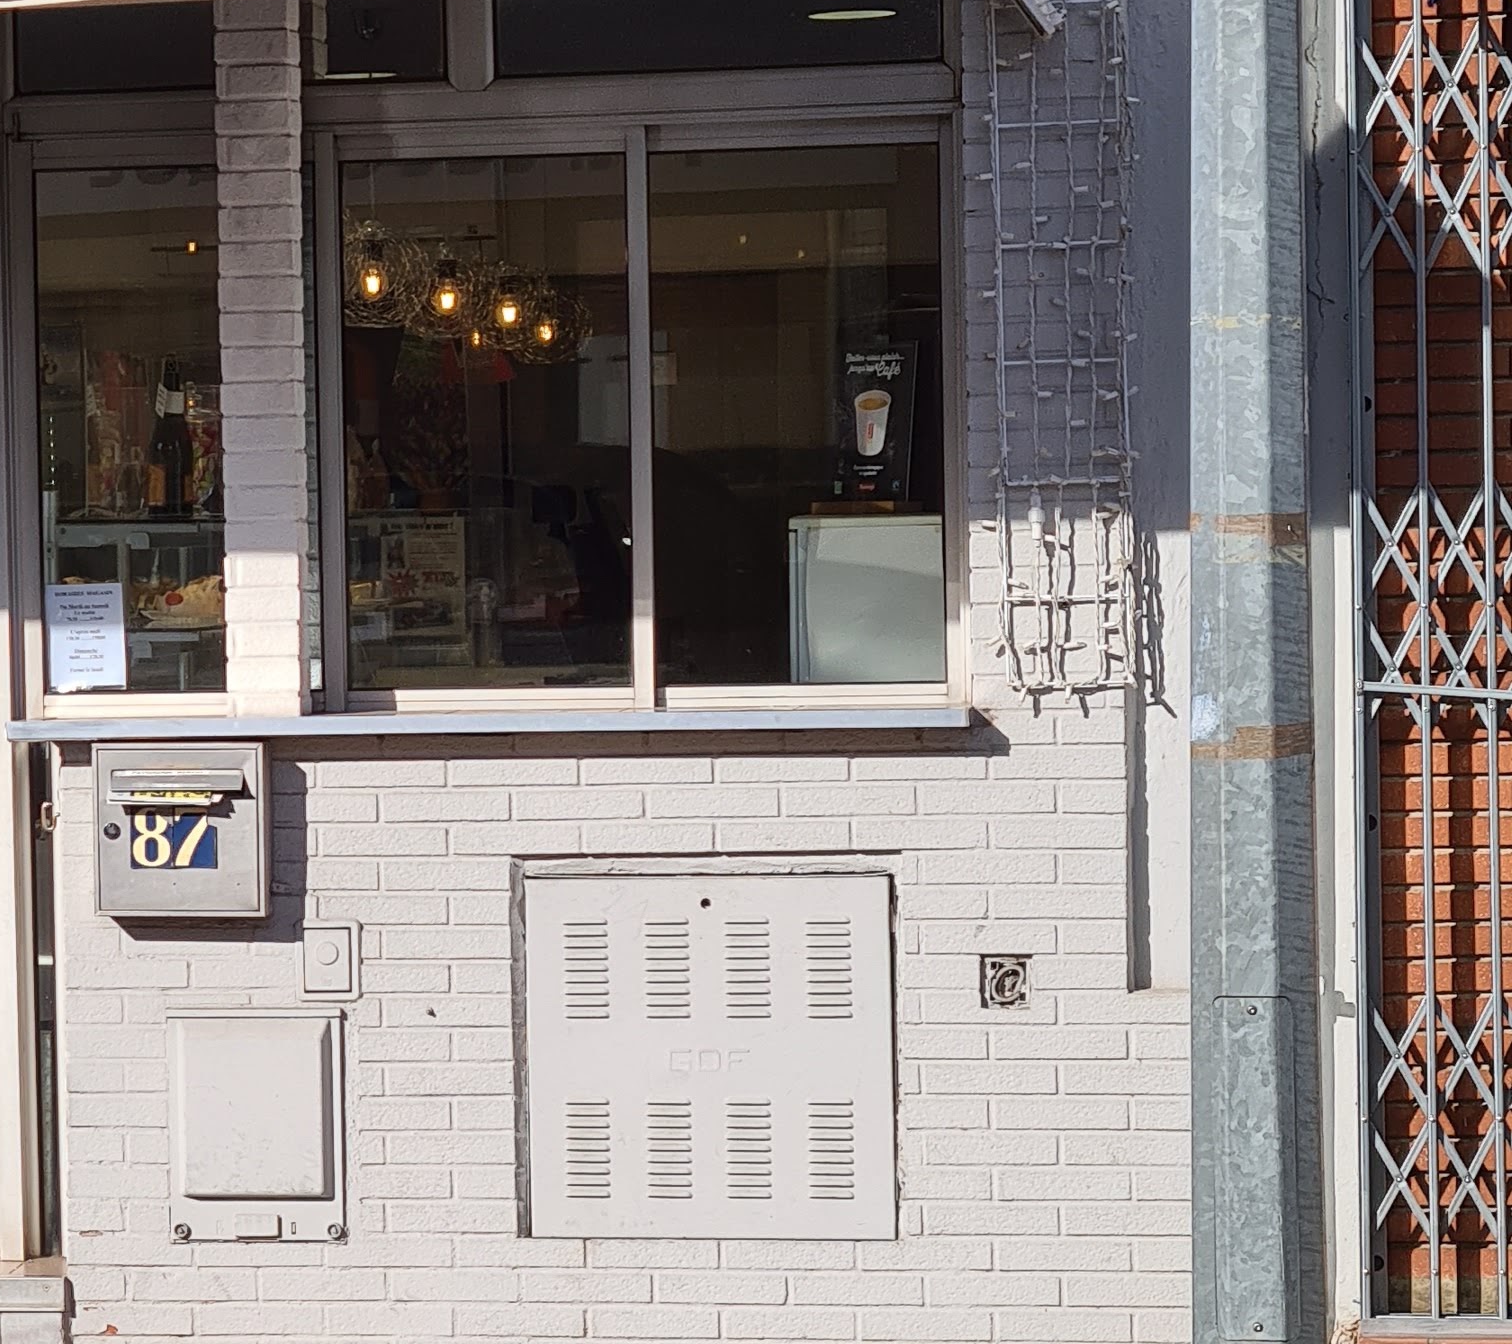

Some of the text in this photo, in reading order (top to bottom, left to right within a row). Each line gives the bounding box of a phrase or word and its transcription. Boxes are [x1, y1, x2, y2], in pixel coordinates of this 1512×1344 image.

[875, 361, 901, 380] Café
[132, 807, 209, 867] 87
[670, 1049, 750, 1072] GDF
